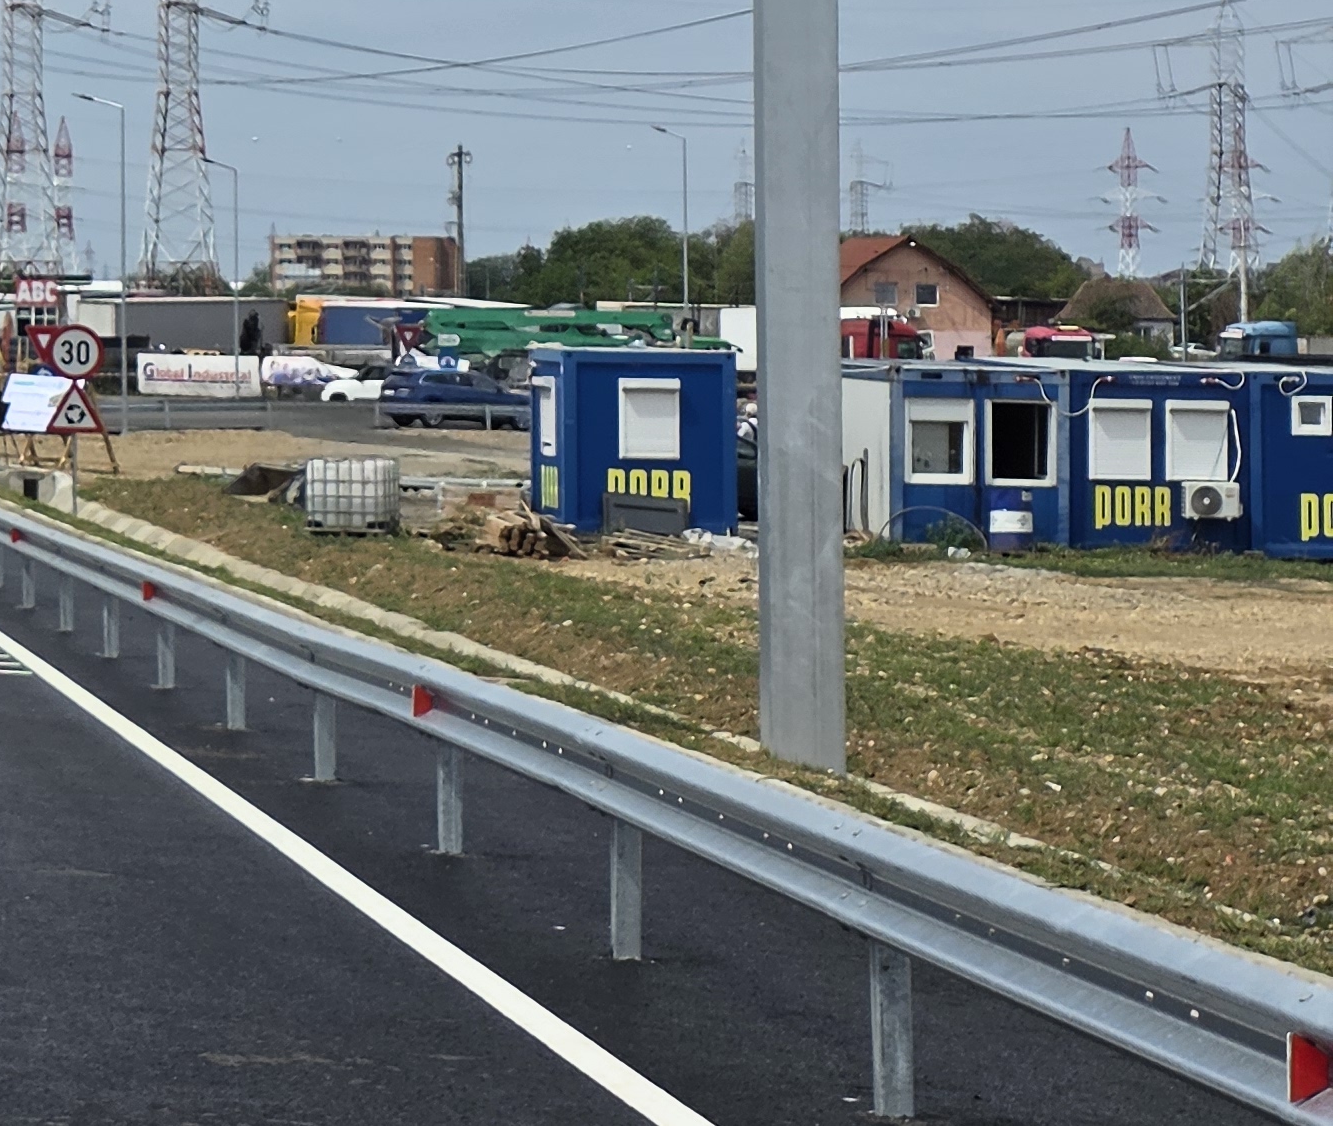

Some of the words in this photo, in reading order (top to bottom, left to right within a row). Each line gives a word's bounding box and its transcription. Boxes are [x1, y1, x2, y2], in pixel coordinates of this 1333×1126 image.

[17, 280, 58, 303] ABC
[60, 339, 90, 366] 30
[143, 362, 184, 379] Global
[188, 363, 252, 381] Industral
[1095, 485, 1171, 530] PORR
